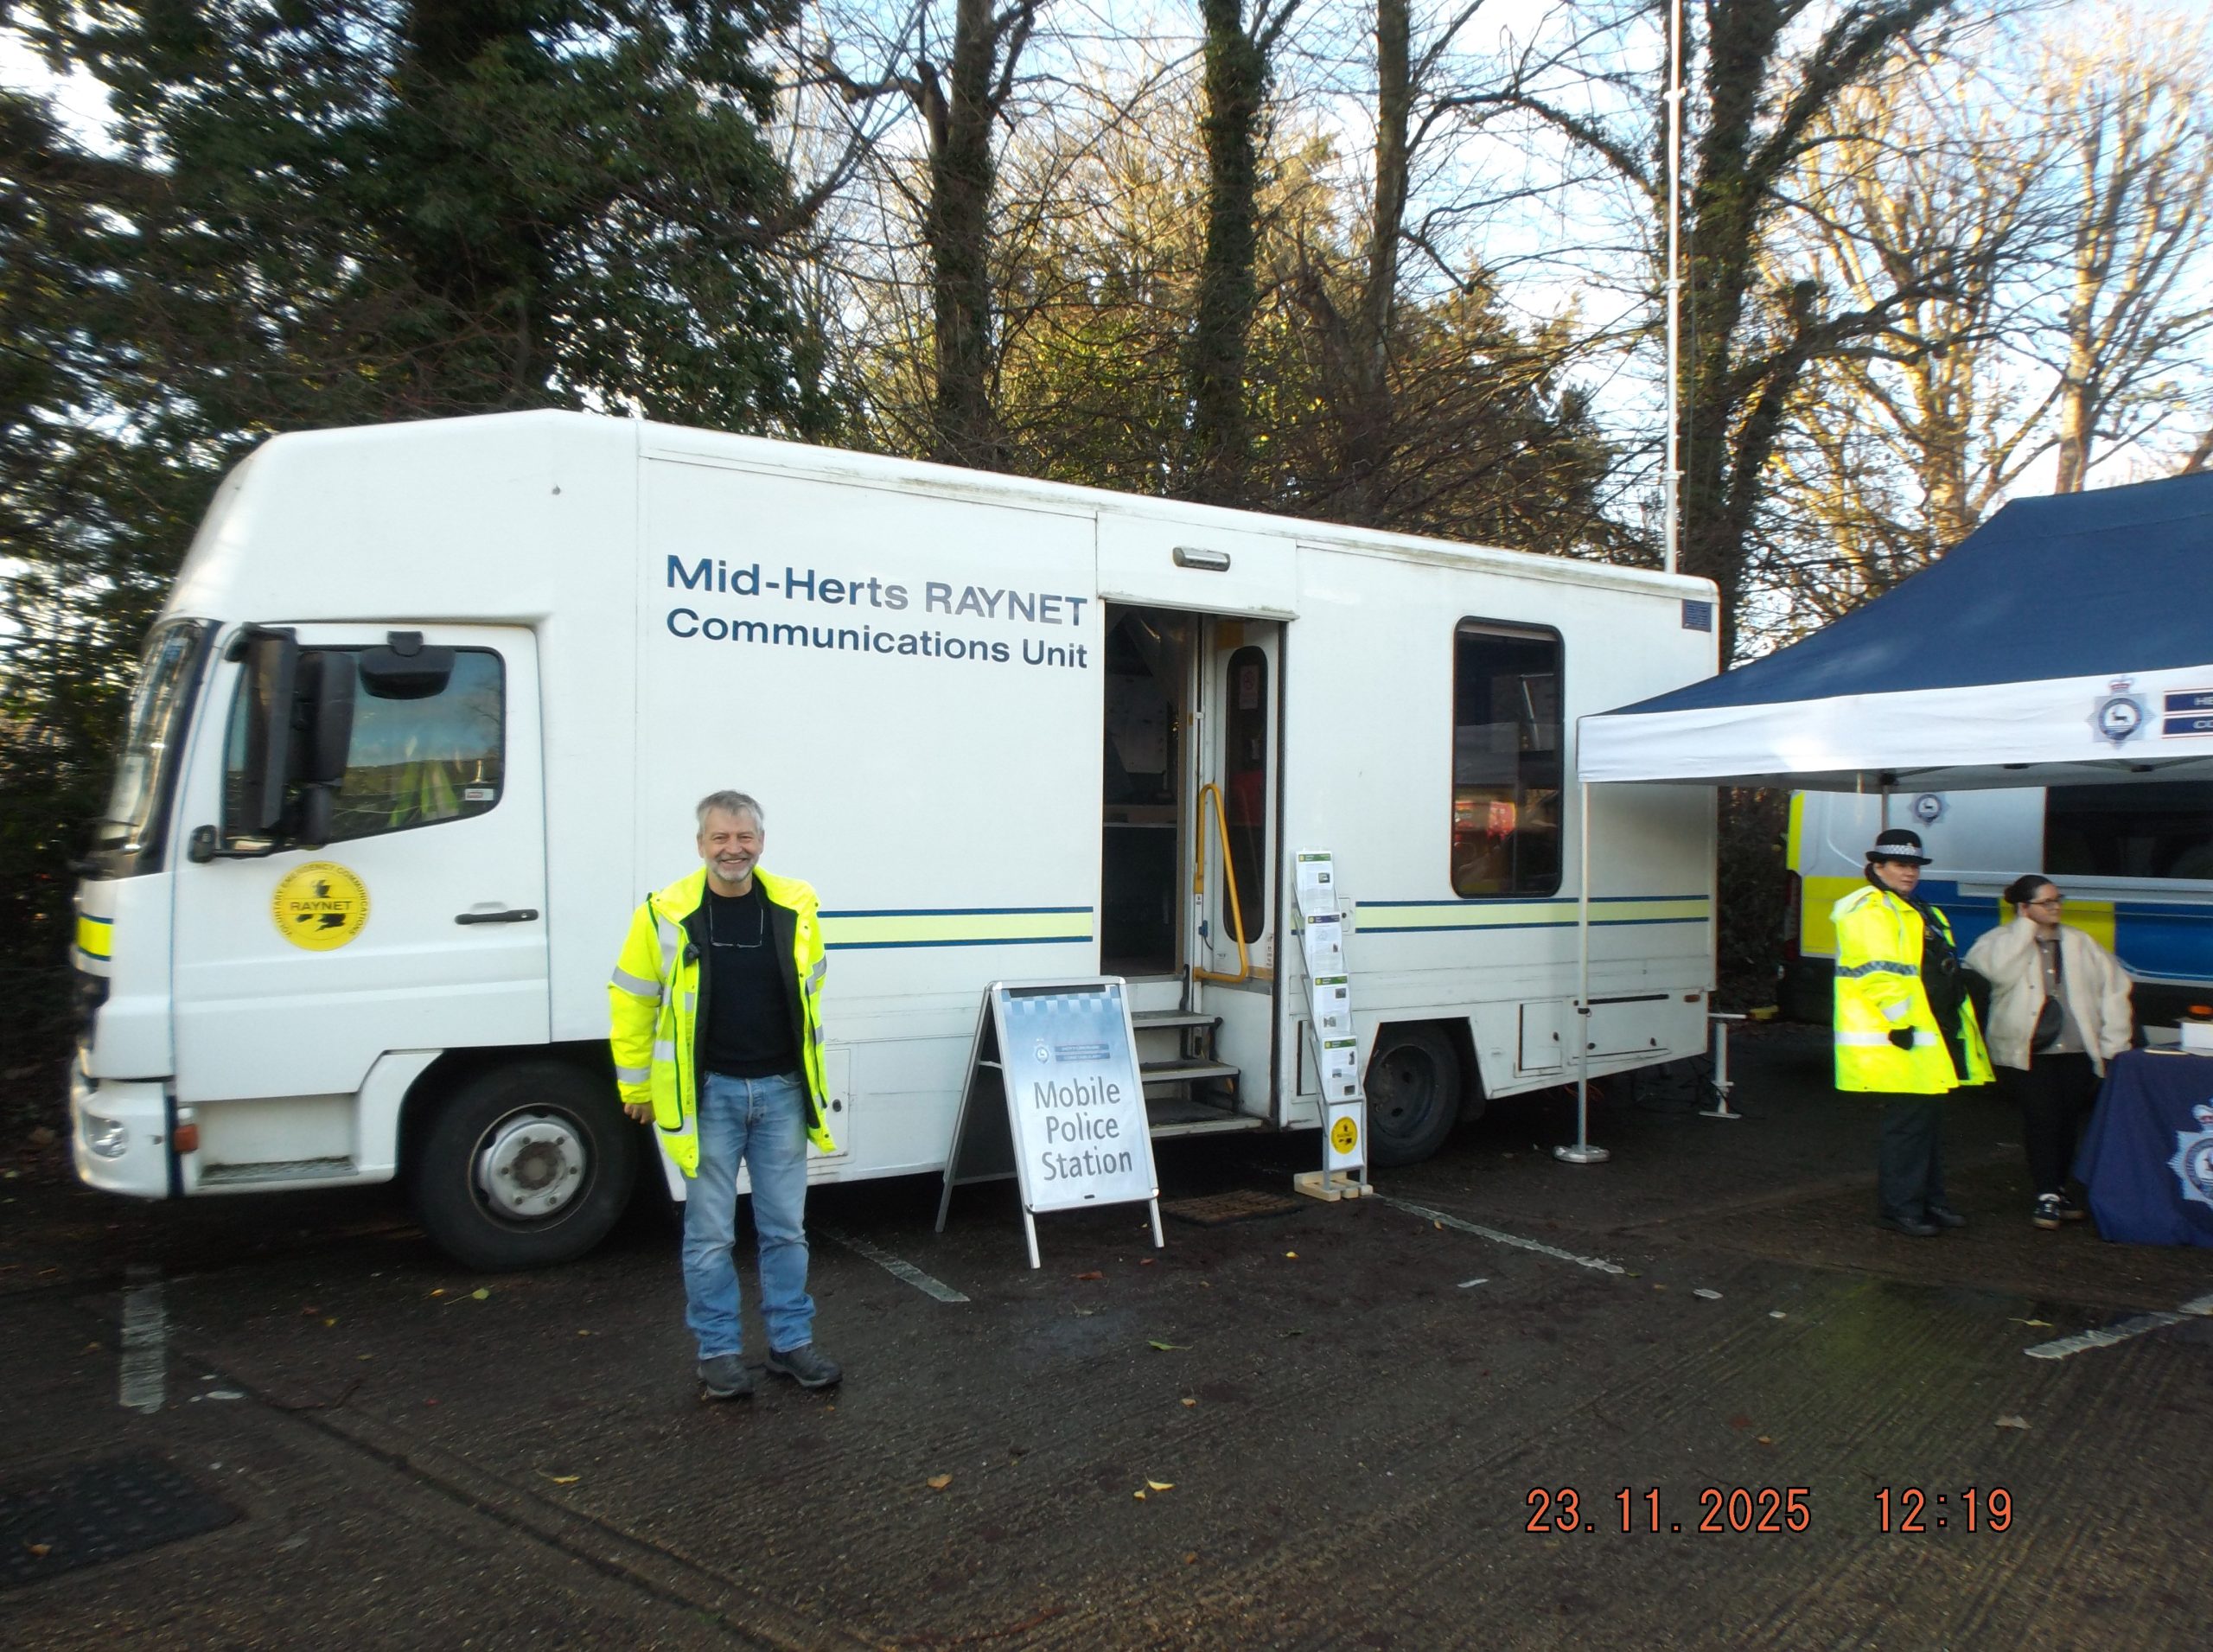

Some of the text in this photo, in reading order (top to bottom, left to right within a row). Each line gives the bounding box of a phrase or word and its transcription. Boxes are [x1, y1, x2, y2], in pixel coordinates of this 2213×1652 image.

[666, 554, 1087, 627] Mid-Herts RAYNET
[666, 608, 1088, 669] Communications Unit
[290, 901, 353, 910] RAYNET
[336, 867, 367, 934] COMMUNICATIONS
[1033, 1075, 1121, 1109] Mobile
[1045, 1112, 1120, 1145] Police
[1041, 1145, 1133, 1181] Station
